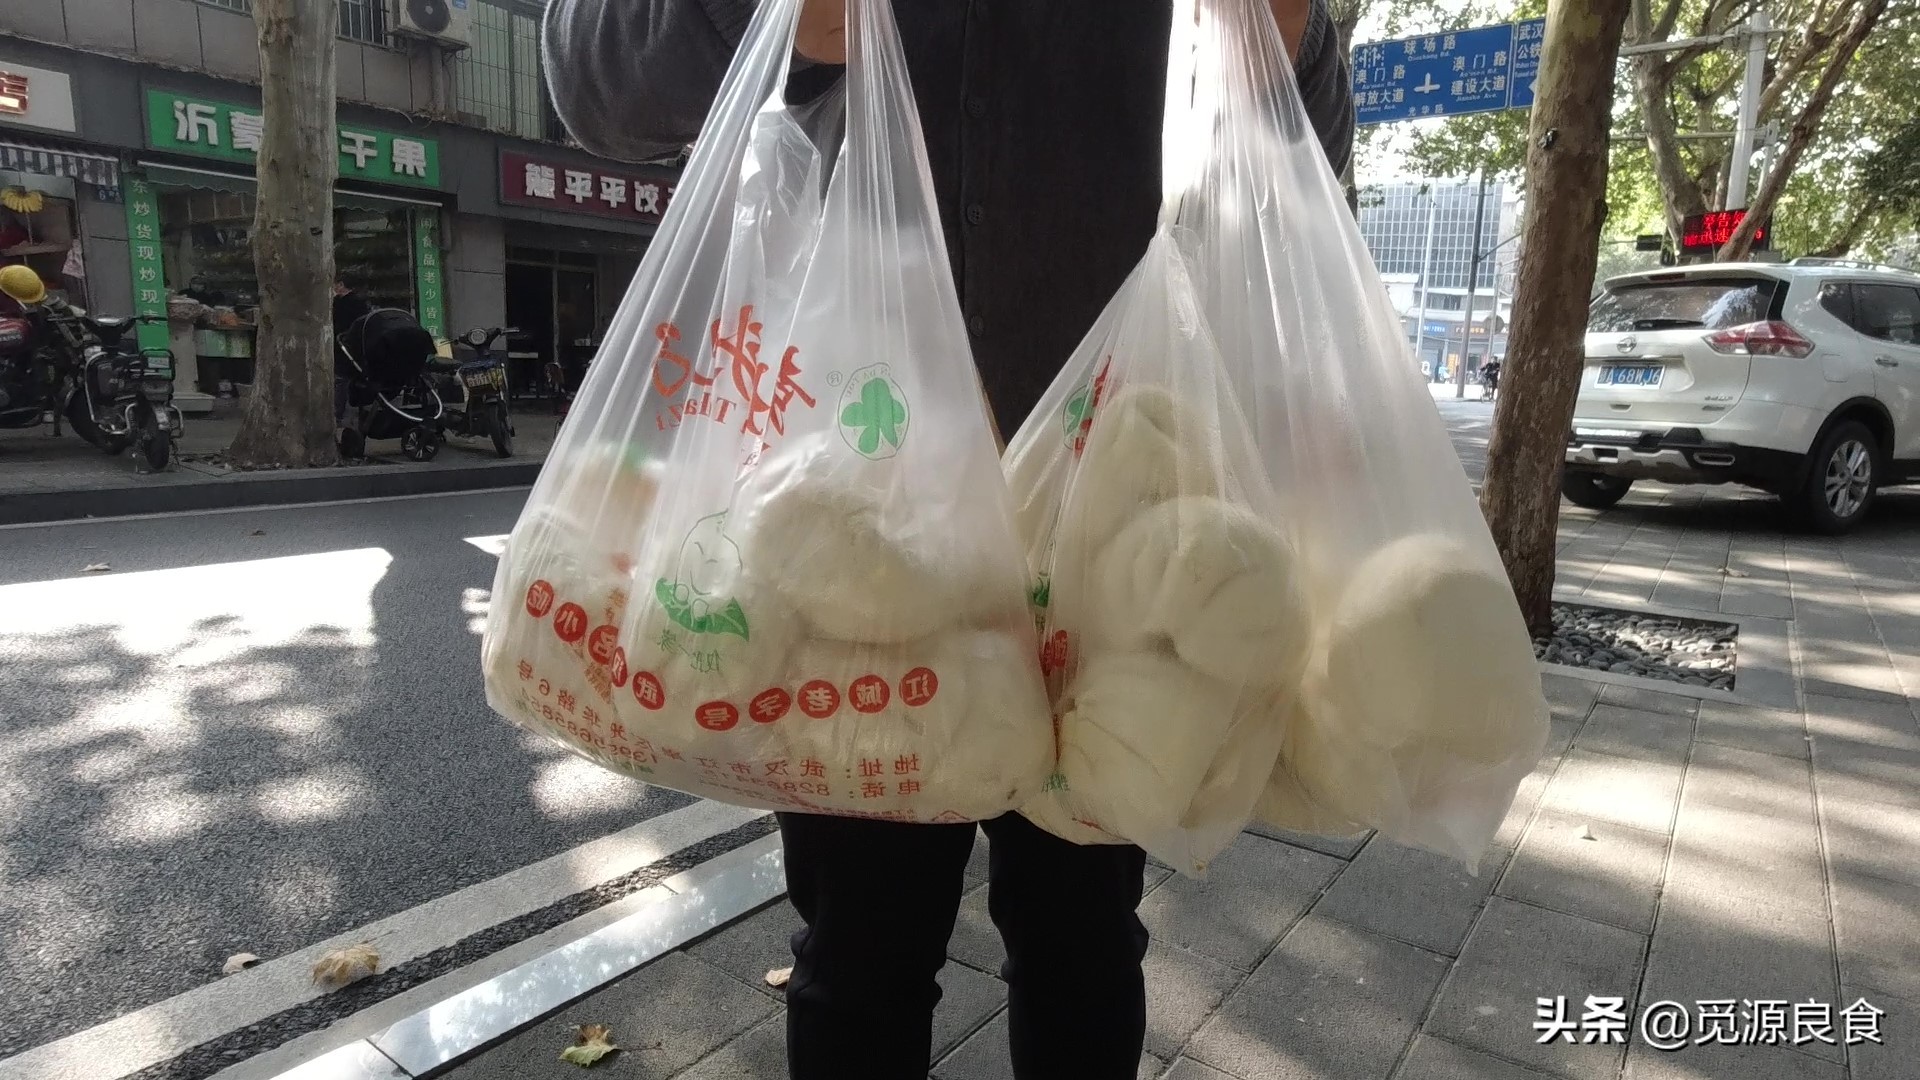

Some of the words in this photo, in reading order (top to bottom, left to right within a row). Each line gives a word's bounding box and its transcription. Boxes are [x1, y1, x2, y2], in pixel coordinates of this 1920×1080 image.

[1519, 22, 1544, 40] 武汉
[1403, 35, 1456, 55] 球场路
[1452, 51, 1507, 72] 澳门路
[1355, 64, 1406, 84] 澳门路
[1451, 76, 1506, 96] 建设大道
[1354, 87, 1405, 107] 解放大道
[173, 100, 427, 177] 沂蒙干果
